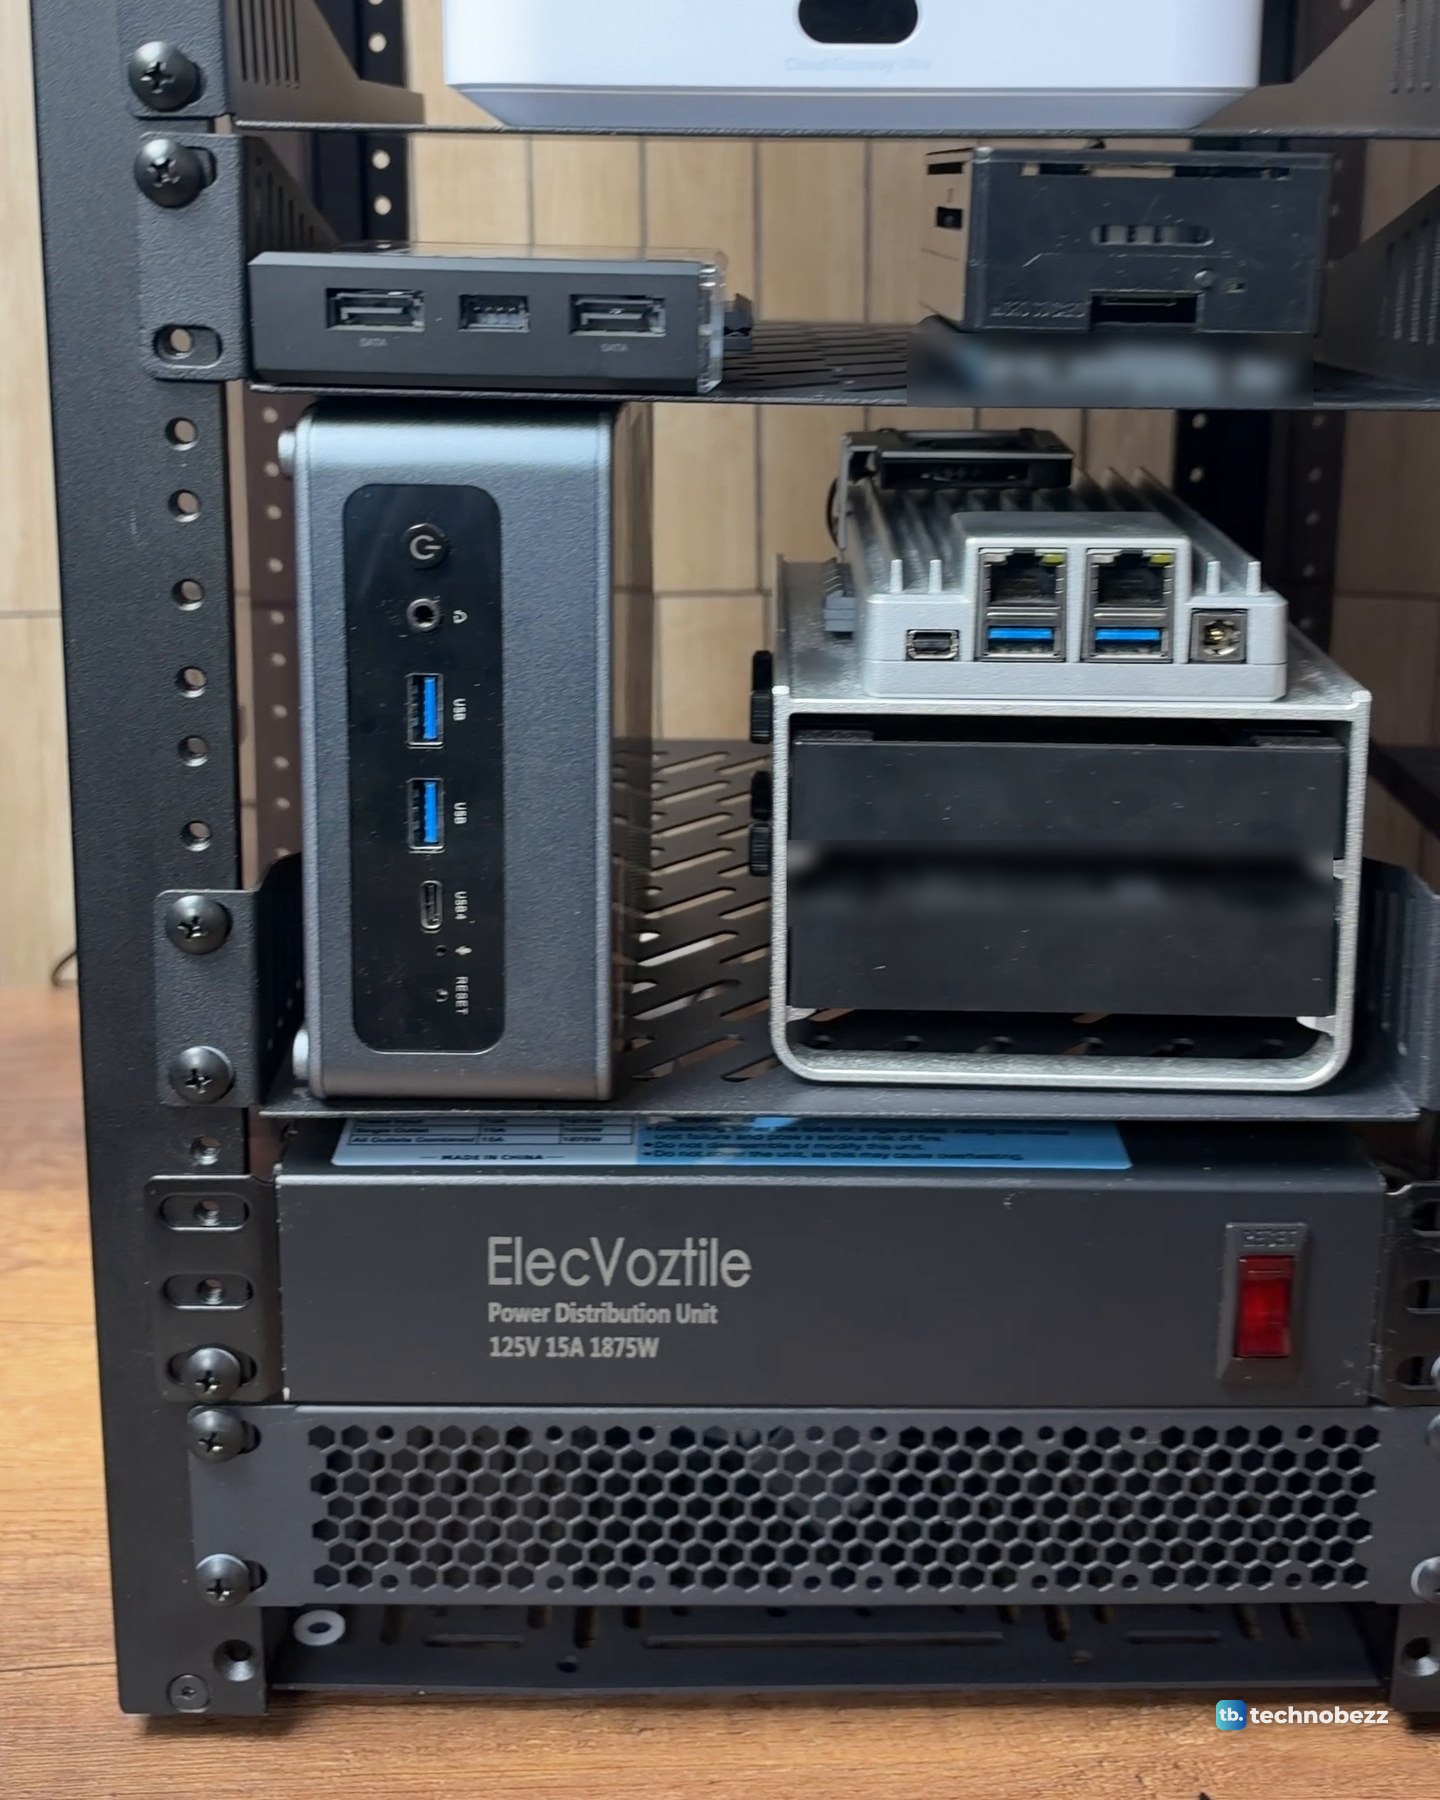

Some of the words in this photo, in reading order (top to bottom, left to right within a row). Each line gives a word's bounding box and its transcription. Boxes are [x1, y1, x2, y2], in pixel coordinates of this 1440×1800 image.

[453, 698, 467, 721] USB
[453, 802, 467, 825] USB
[454, 891, 468, 920] USB4
[455, 976, 469, 1015] RESET
[654, 1141, 676, 1149] Do
[488, 1236, 752, 1288] ElecVoztile
[488, 1302, 551, 1323] Power
[554, 1302, 672, 1324] Distribution
[675, 1302, 719, 1324] Unit
[489, 1336, 542, 1358] 125V
[546, 1336, 586, 1358] 15A
[590, 1336, 660, 1358] 1875W
